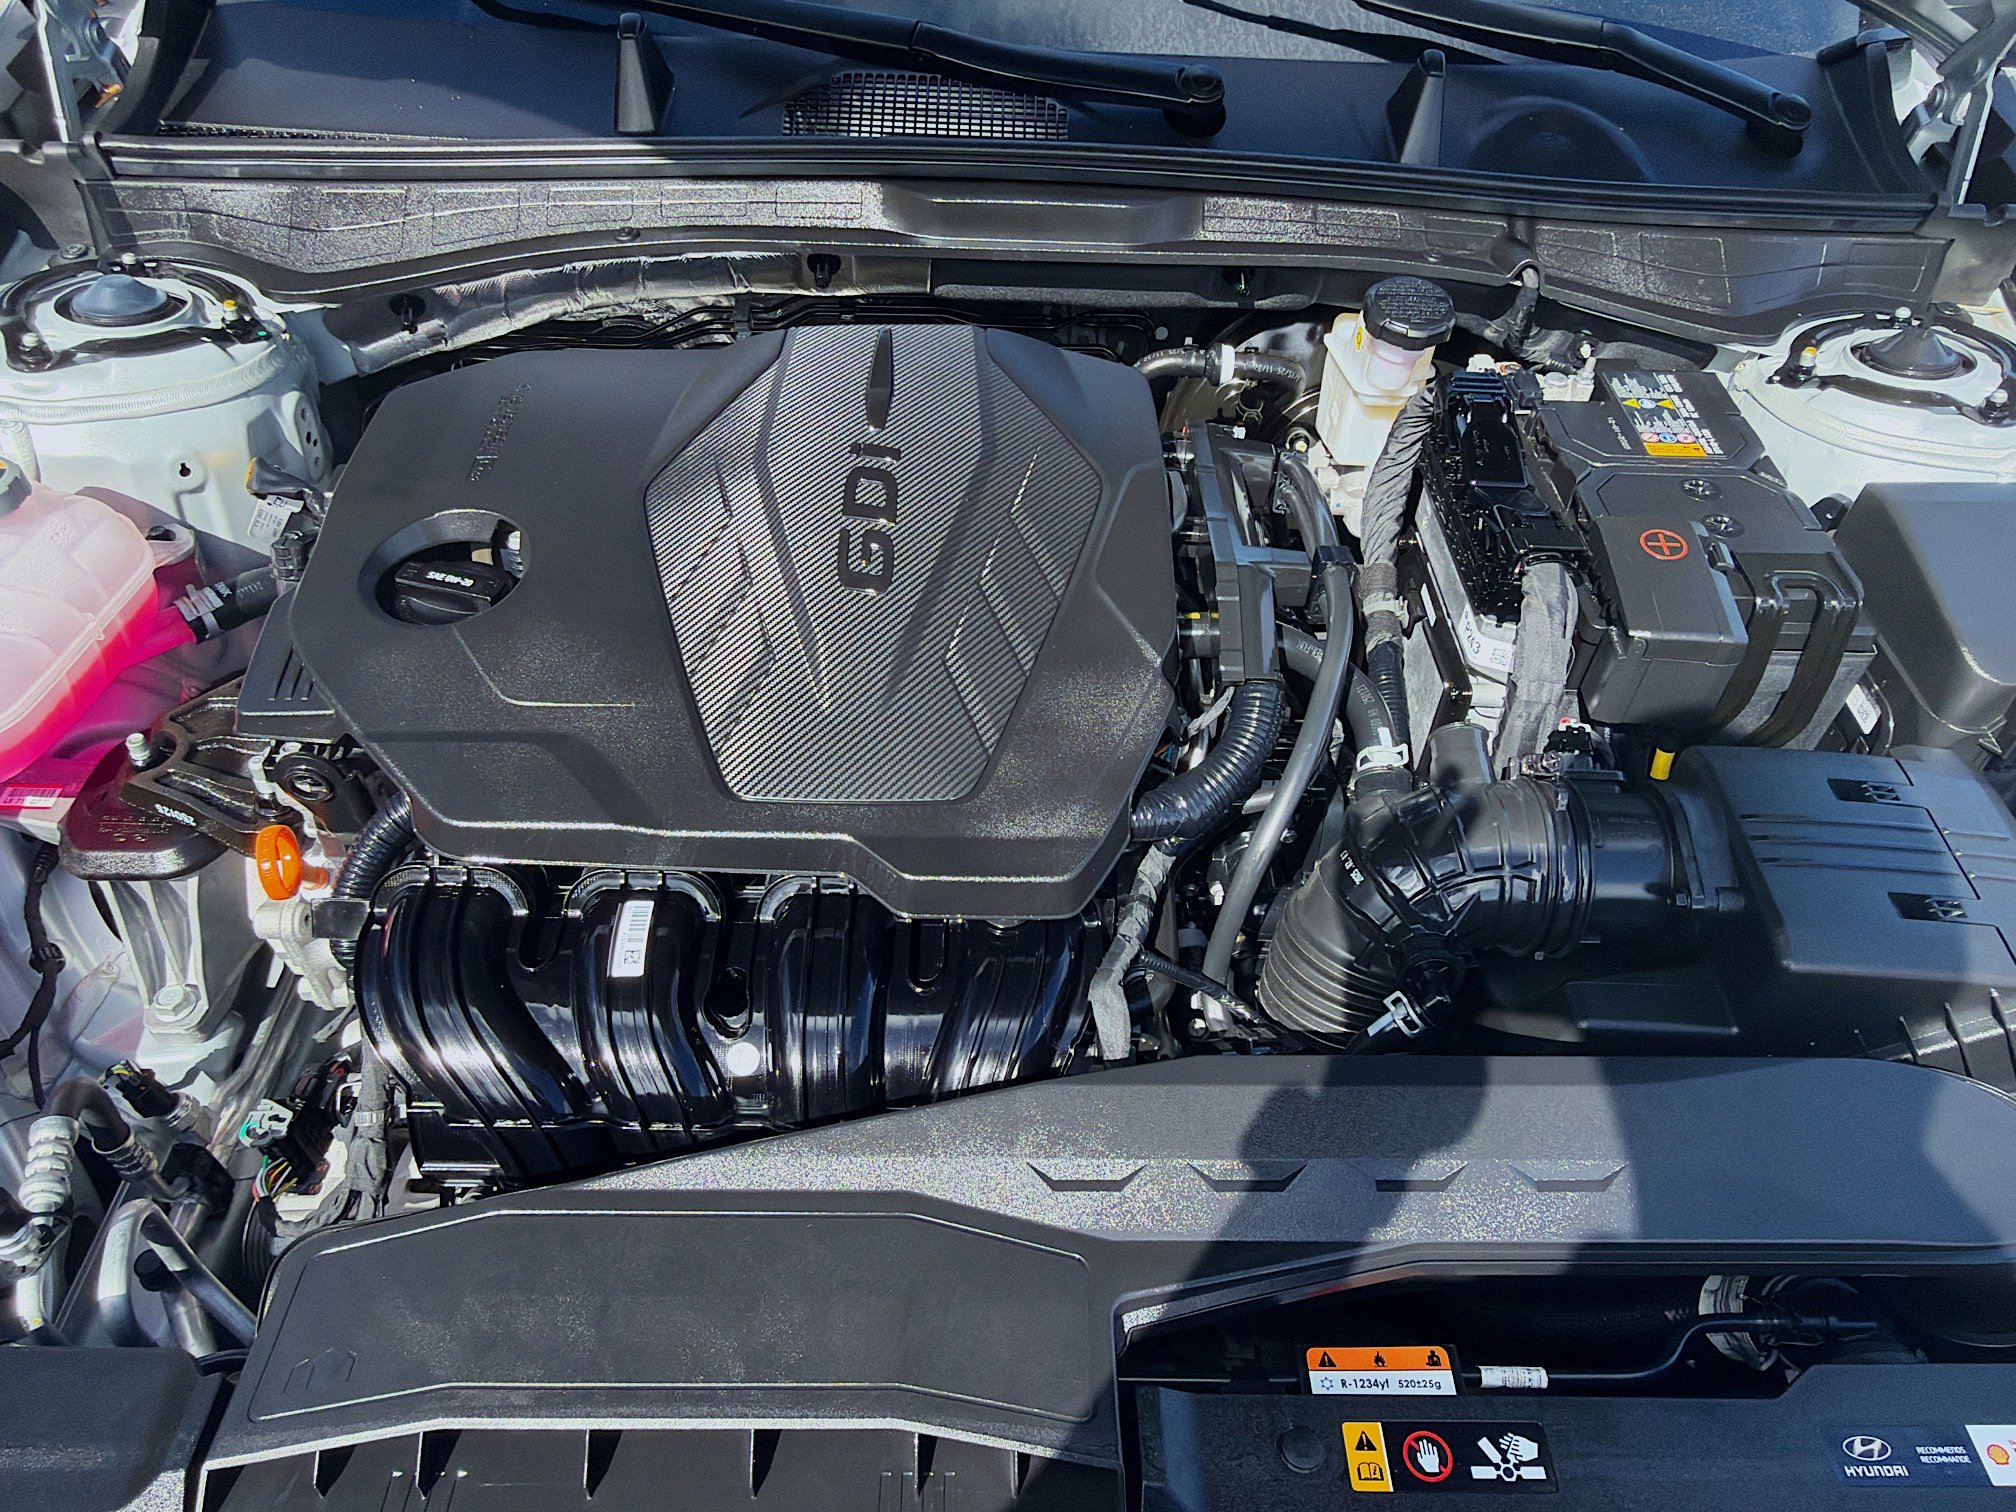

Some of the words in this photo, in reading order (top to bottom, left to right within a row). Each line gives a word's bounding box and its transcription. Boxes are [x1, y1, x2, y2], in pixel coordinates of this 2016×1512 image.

[426, 571, 447, 582] SAE
[1340, 1378, 1390, 1391] R-1234yf
[1398, 1379, 1442, 1390] 520±25g
[1915, 1446, 1967, 1454] RECOMMENDS
[1920, 1455, 1971, 1464] RECOMMANDE
[1844, 1465, 1910, 1477] HYUNDAI
